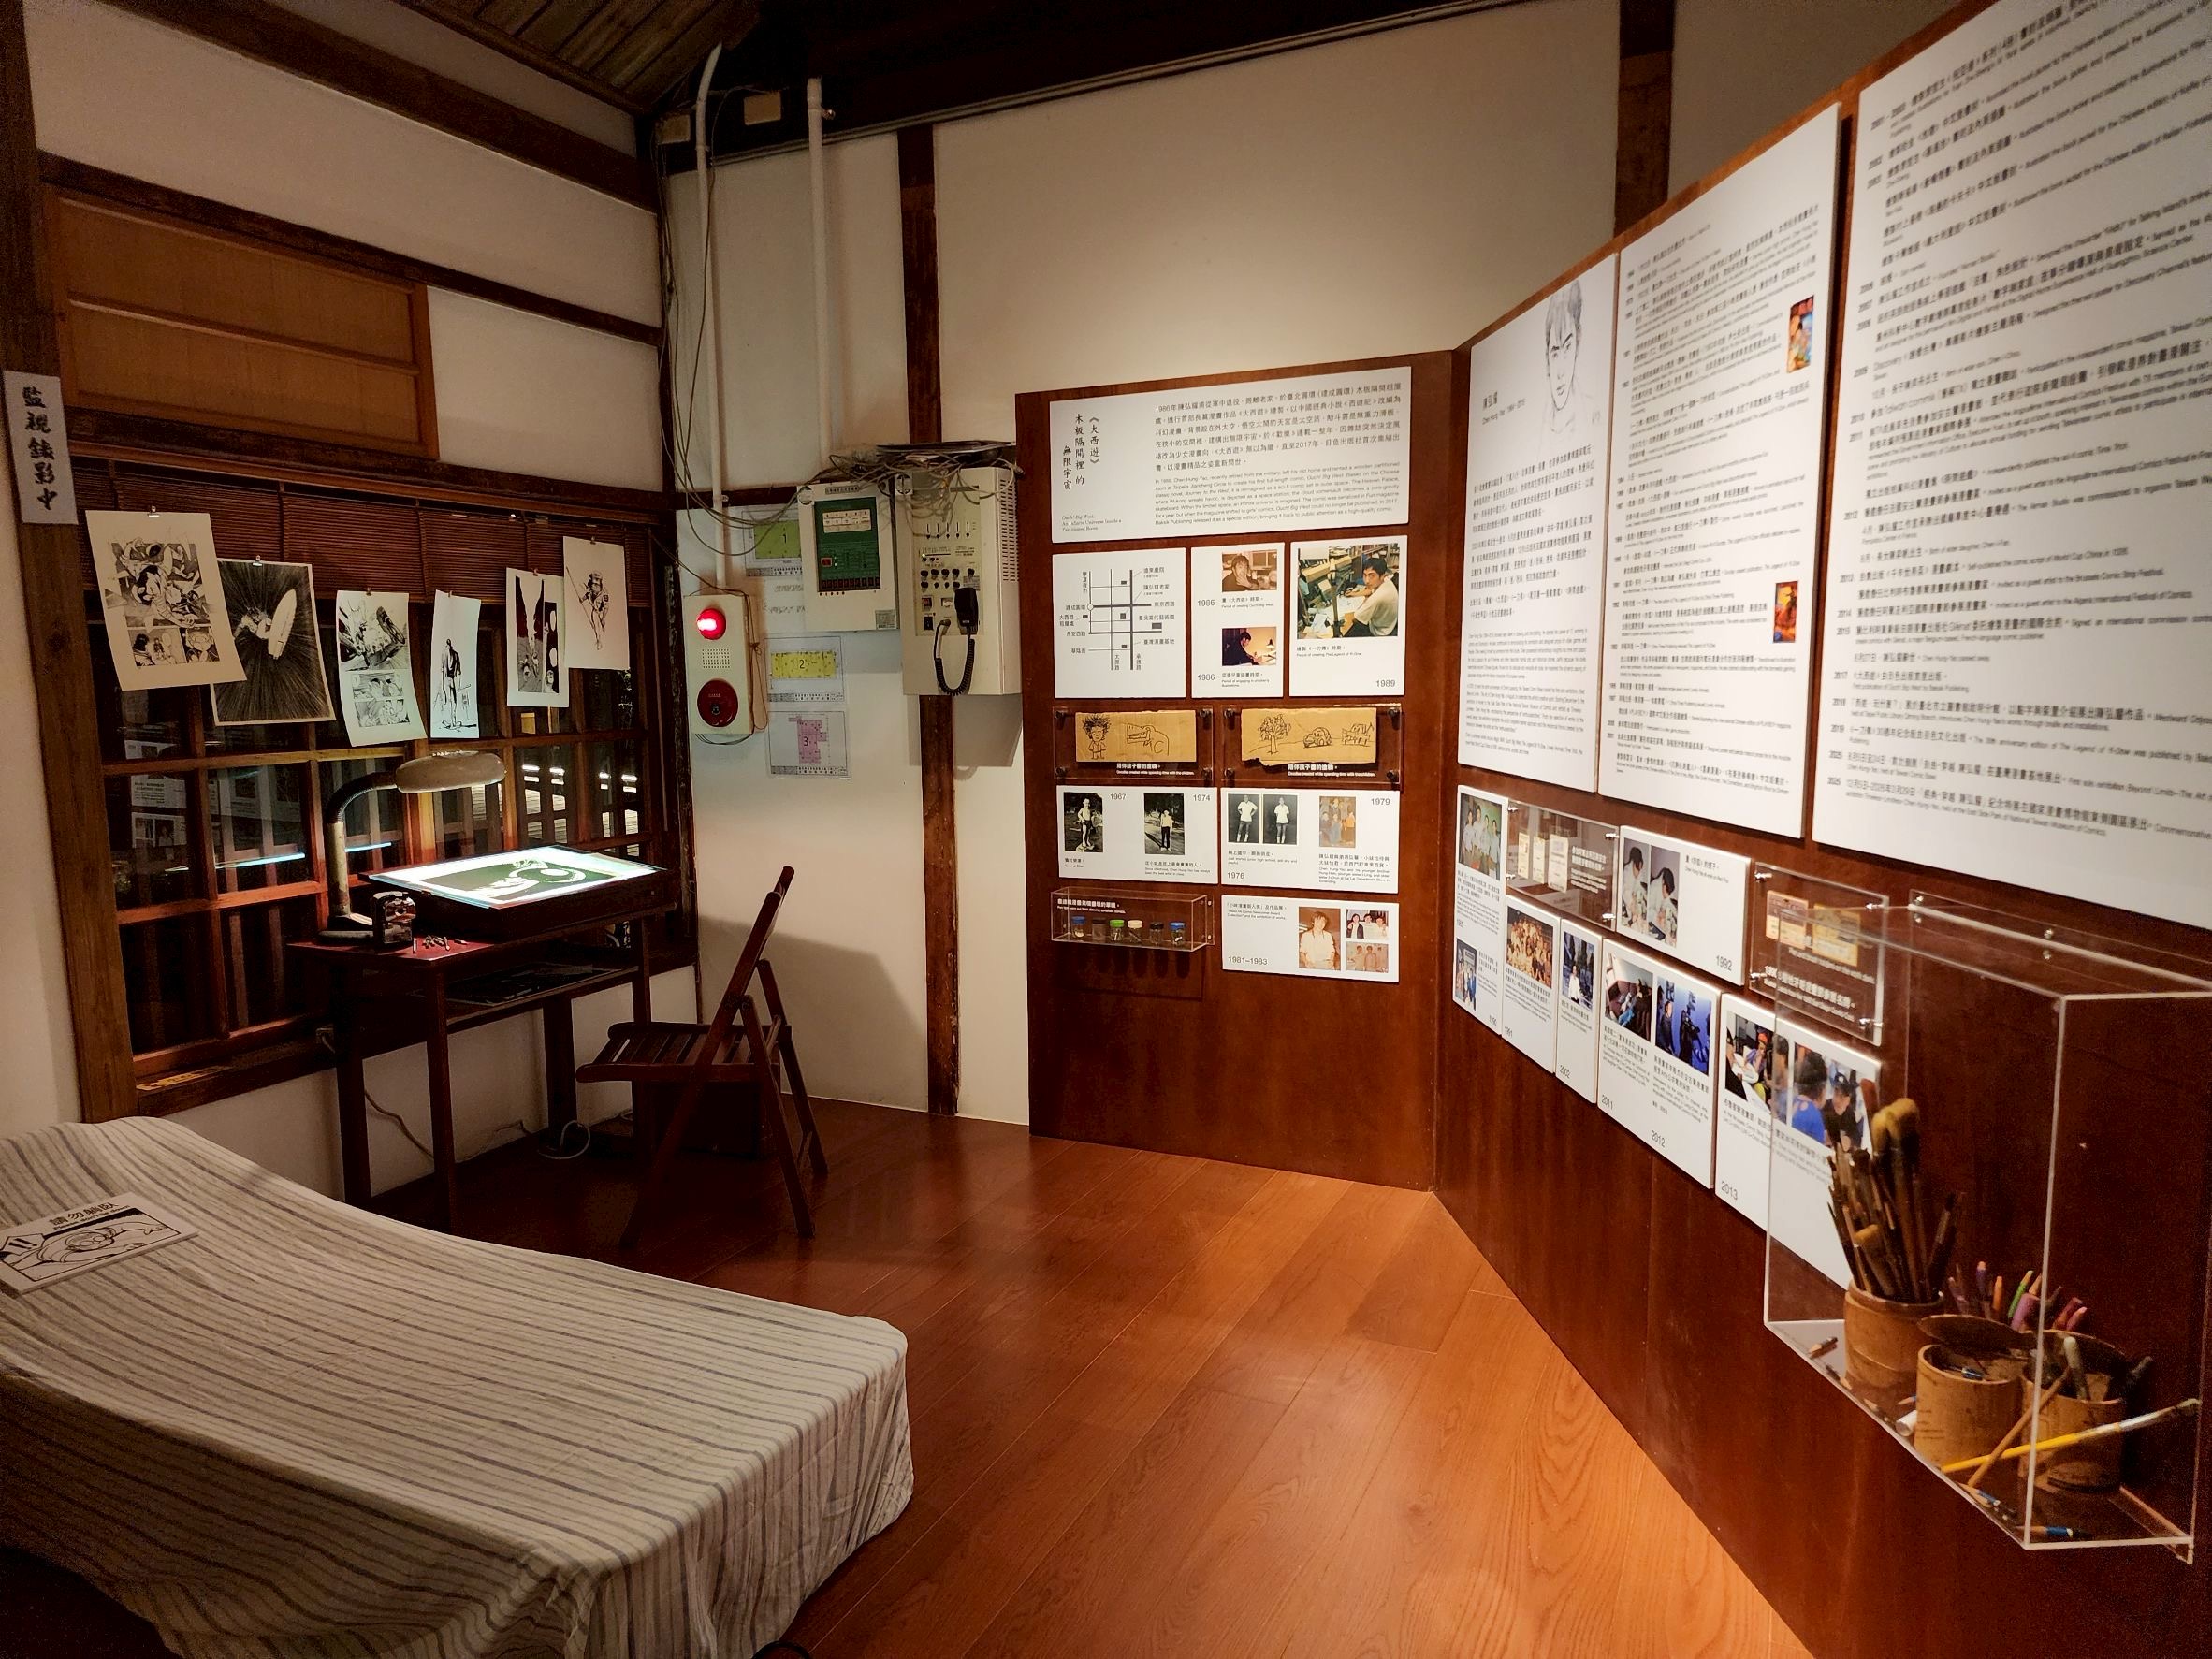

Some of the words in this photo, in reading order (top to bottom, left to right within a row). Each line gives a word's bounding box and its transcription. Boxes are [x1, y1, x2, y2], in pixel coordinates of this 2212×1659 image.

[22, 386, 57, 511] 監視錄影中
[1088, 416, 1099, 463] 《大西遊》
[1074, 413, 1084, 486] 木板隔間裡的
[1062, 444, 1071, 489] 無限宇宙
[798, 658, 806, 670] 2
[802, 735, 810, 748] 3
[1716, 954, 1733, 971] 1992
[1601, 1095, 1615, 1110] 2011
[1651, 1130, 1666, 1148] 2012
[1721, 1181, 1739, 1201] 2013
